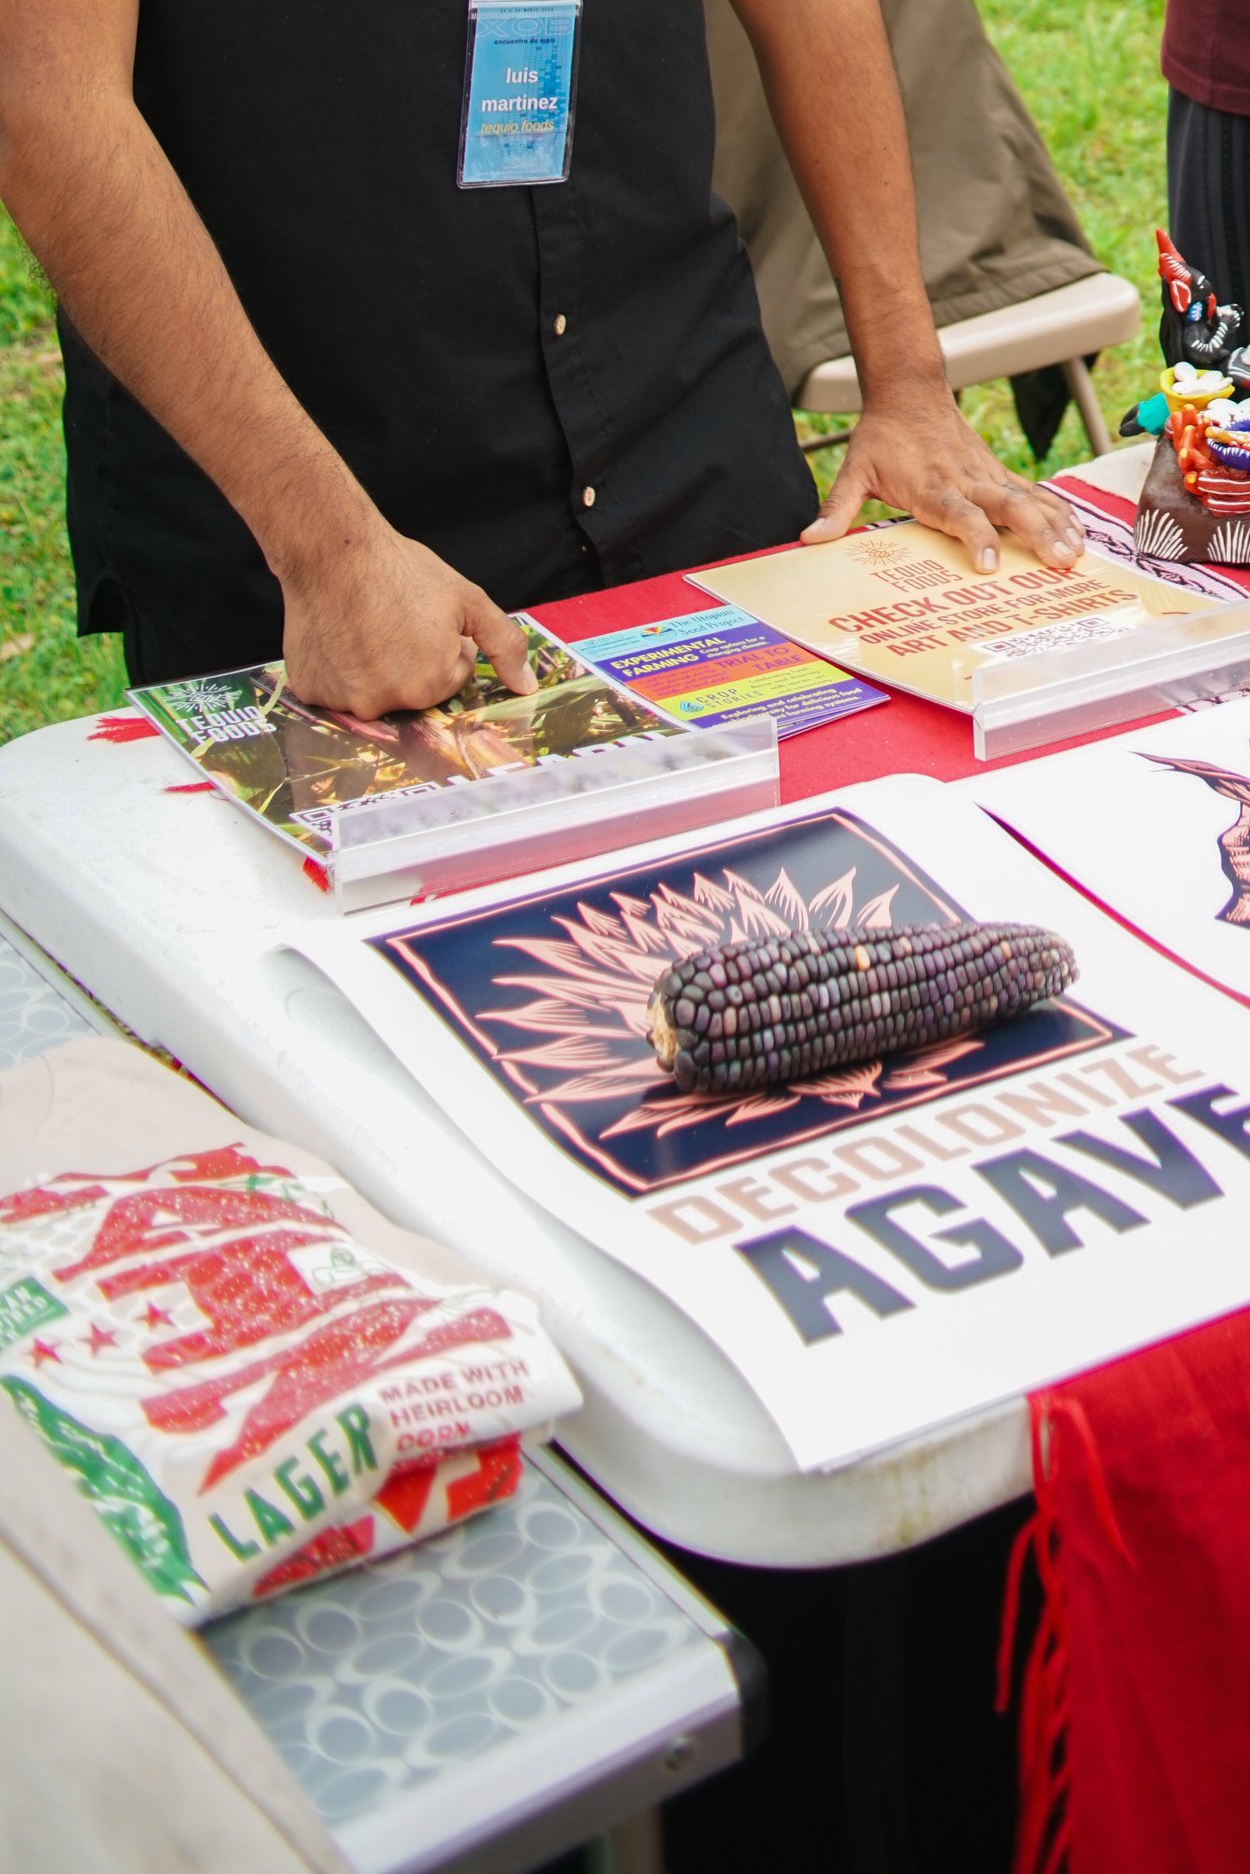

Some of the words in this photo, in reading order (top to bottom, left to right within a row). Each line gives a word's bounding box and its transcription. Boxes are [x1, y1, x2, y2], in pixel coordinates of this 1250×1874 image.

[506, 67, 538, 84] luis
[481, 94, 558, 112] martinez
[480, 121, 518, 135] tequio
[521, 119, 554, 133] foods
[870, 559, 945, 584] TEQUIO
[892, 569, 963, 593] FOODS
[828, 596, 946, 634] CHECK
[945, 579, 1012, 610] OUT
[1009, 565, 1088, 593] OUR
[670, 618, 690, 629] The
[691, 609, 735, 623] Utopian
[859, 618, 944, 645] ONLINE
[938, 603, 1011, 629] STORE
[1007, 592, 1051, 616] FOR
[1042, 579, 1111, 604] MORE
[885, 634, 948, 657] ART
[947, 619, 1015, 644] AND
[1006, 589, 1139, 629] T-SHIRTS
[678, 626, 706, 636] Seed
[706, 616, 745, 629] Project
[610, 637, 727, 669] EXPERIMENTAL
[699, 647, 719, 655] Crop
[719, 638, 746, 650] options
[706, 647, 742, 659] changing
[715, 654, 764, 669] TRIAL
[764, 647, 790, 658] TO
[622, 654, 699, 677] FARMING
[752, 654, 803, 672] TABLE
[695, 688, 738, 704] CROP
[705, 690, 764, 708] STORIES
[720, 705, 768, 719] Exploring
[766, 699, 786, 708] and
[786, 688, 837, 703] celebrating
[839, 687, 863, 697] food
[175, 706, 259, 734] TEQUIO
[786, 704, 825, 716] farming
[192, 718, 277, 744] FOODS
[646, 1043, 1207, 1247] DECOLONIZE
[377, 1373, 460, 1405] MADE
[459, 1361, 531, 1387] WITH
[389, 1385, 525, 1428] HEIRLOOM
[207, 1402, 379, 1567] LAGER
